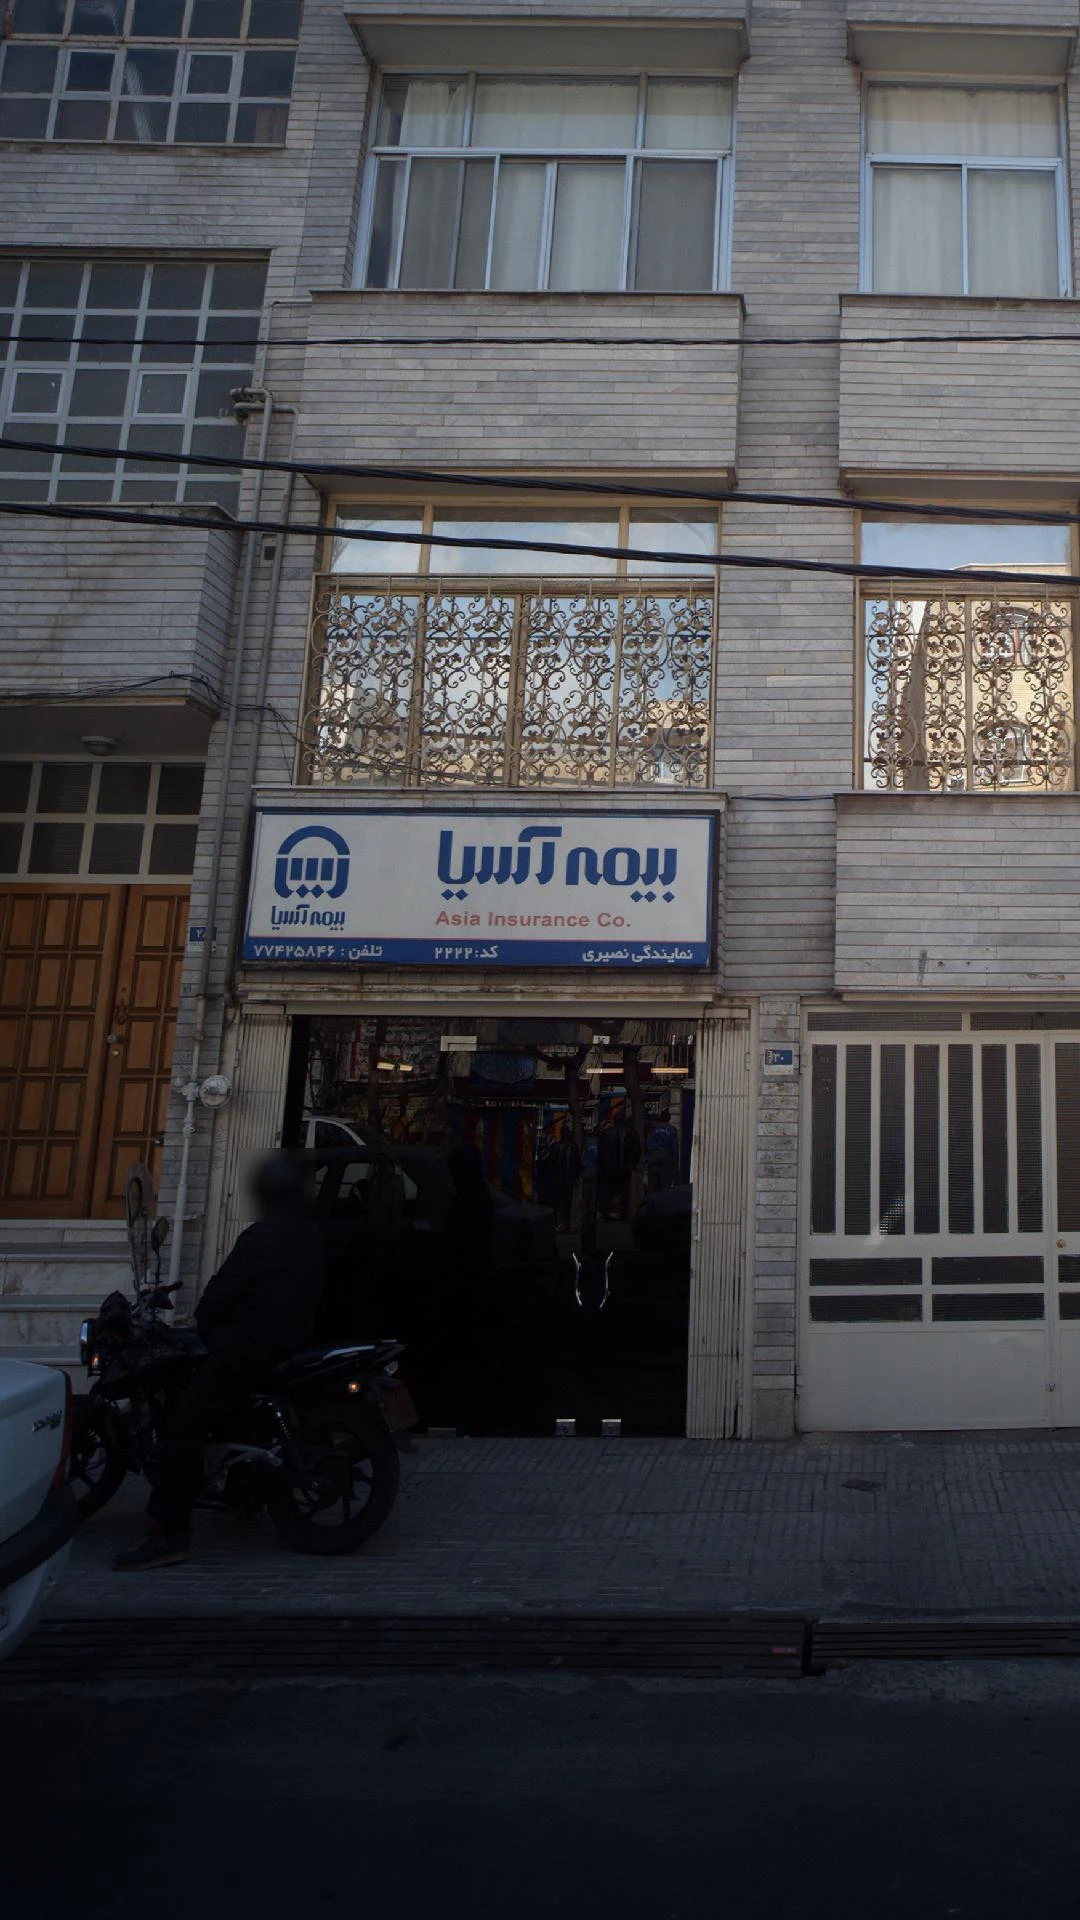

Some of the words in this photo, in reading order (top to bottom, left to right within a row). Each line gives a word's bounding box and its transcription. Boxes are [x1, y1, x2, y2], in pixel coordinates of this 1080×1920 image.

[437, 826, 563, 901] آسیا
[565, 847, 678, 904] بیمه
[271, 904, 310, 931] آسیا
[309, 910, 346, 932] بیمه
[435, 911, 481, 927] Asia
[488, 912, 590, 928] Insurance
[597, 912, 631, 928] Co.
[582, 948, 630, 962] نصیری
[631, 944, 694, 962] نمایندگی
